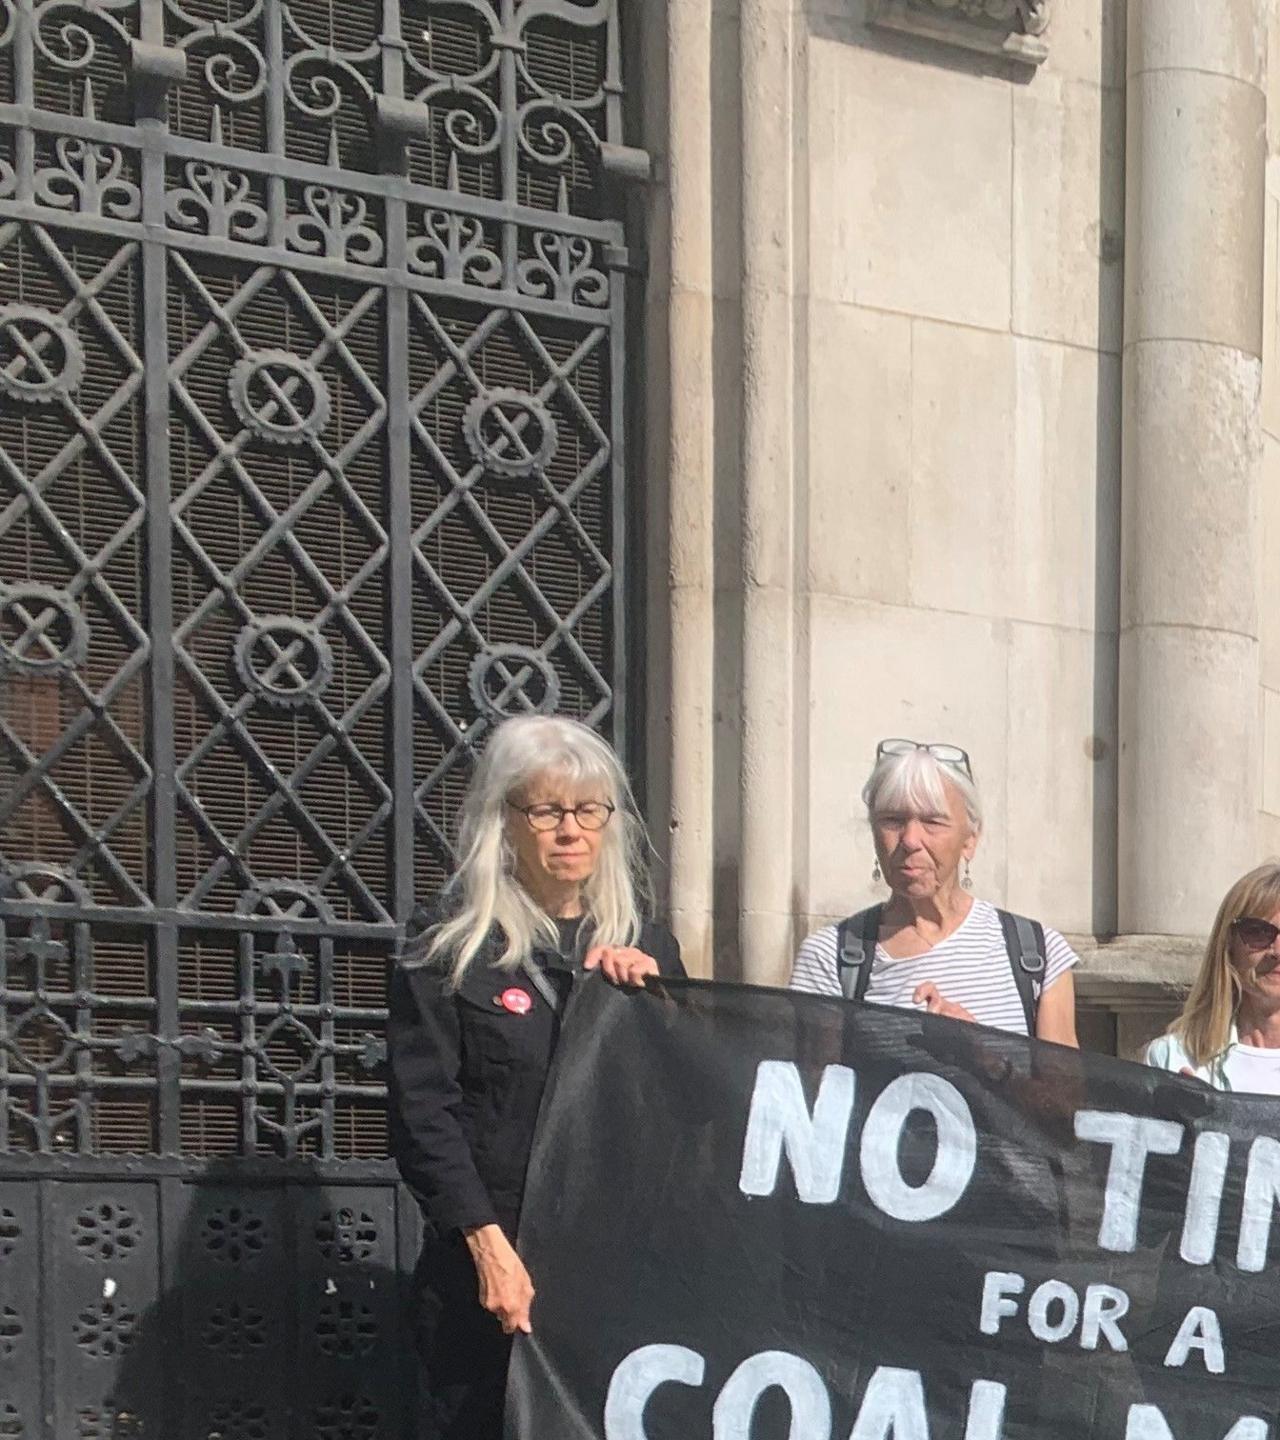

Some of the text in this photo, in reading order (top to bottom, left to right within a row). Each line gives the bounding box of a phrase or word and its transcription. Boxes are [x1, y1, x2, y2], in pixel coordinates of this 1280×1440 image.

[739, 1060, 977, 1222] NO
[980, 1270, 1226, 1374] FOR A
